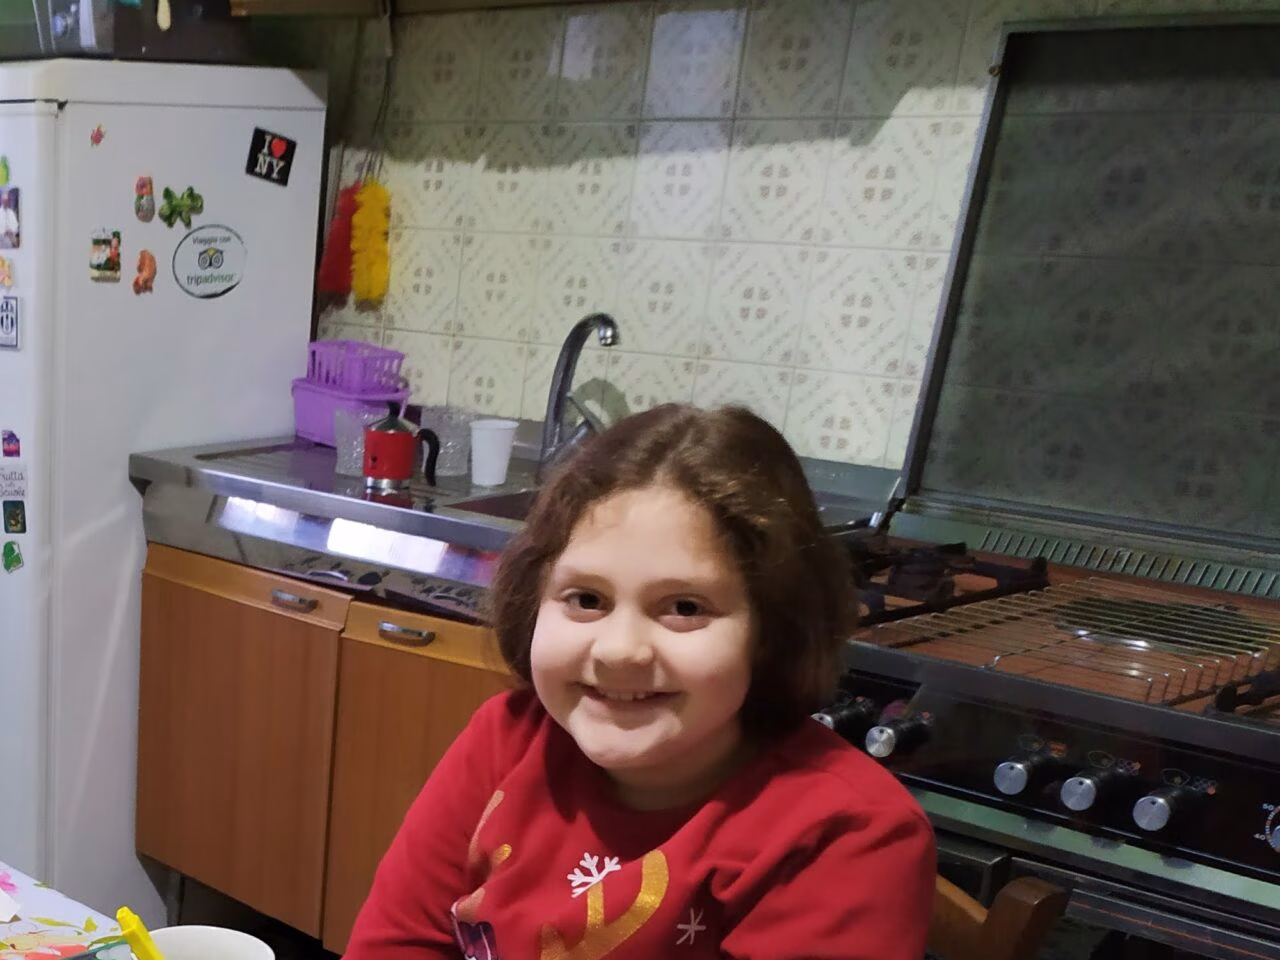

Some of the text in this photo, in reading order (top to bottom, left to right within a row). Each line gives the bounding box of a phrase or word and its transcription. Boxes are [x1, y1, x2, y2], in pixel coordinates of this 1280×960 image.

[261, 134, 272, 154] I
[254, 153, 285, 179] NY
[187, 273, 234, 287] tripadvisor
